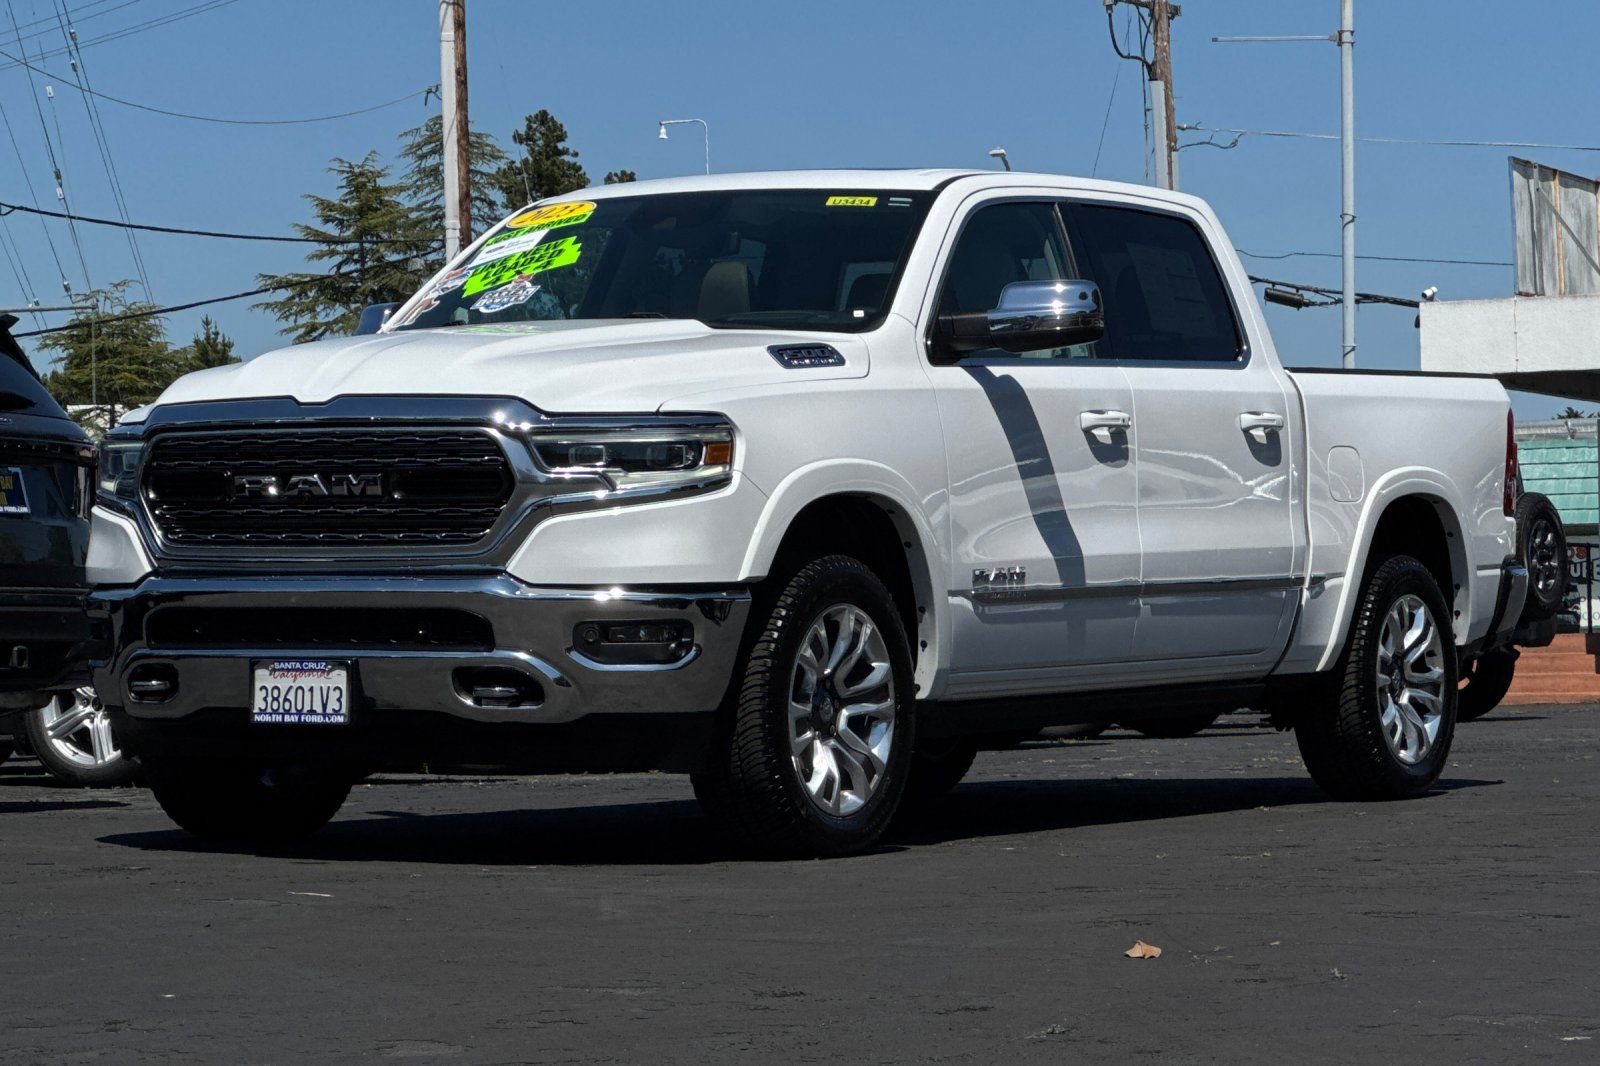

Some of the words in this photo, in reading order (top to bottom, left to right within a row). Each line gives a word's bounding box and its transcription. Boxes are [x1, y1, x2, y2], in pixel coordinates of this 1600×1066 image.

[832, 198, 871, 206] U3434
[513, 203, 586, 225] 2023
[528, 213, 588, 231] ARRIVED
[470, 256, 512, 277] LIKE
[518, 239, 567, 258] NEW
[480, 248, 563, 281] LOADED
[779, 348, 829, 360] 1500
[233, 474, 383, 497] RAM
[273, 662, 301, 670] SANTA
[302, 662, 326, 670] CRUZ
[258, 685, 343, 713] 38601V3
[254, 713, 282, 722] NORTH
[284, 713, 298, 723] BAY
[301, 714, 344, 723] FORD.COM
